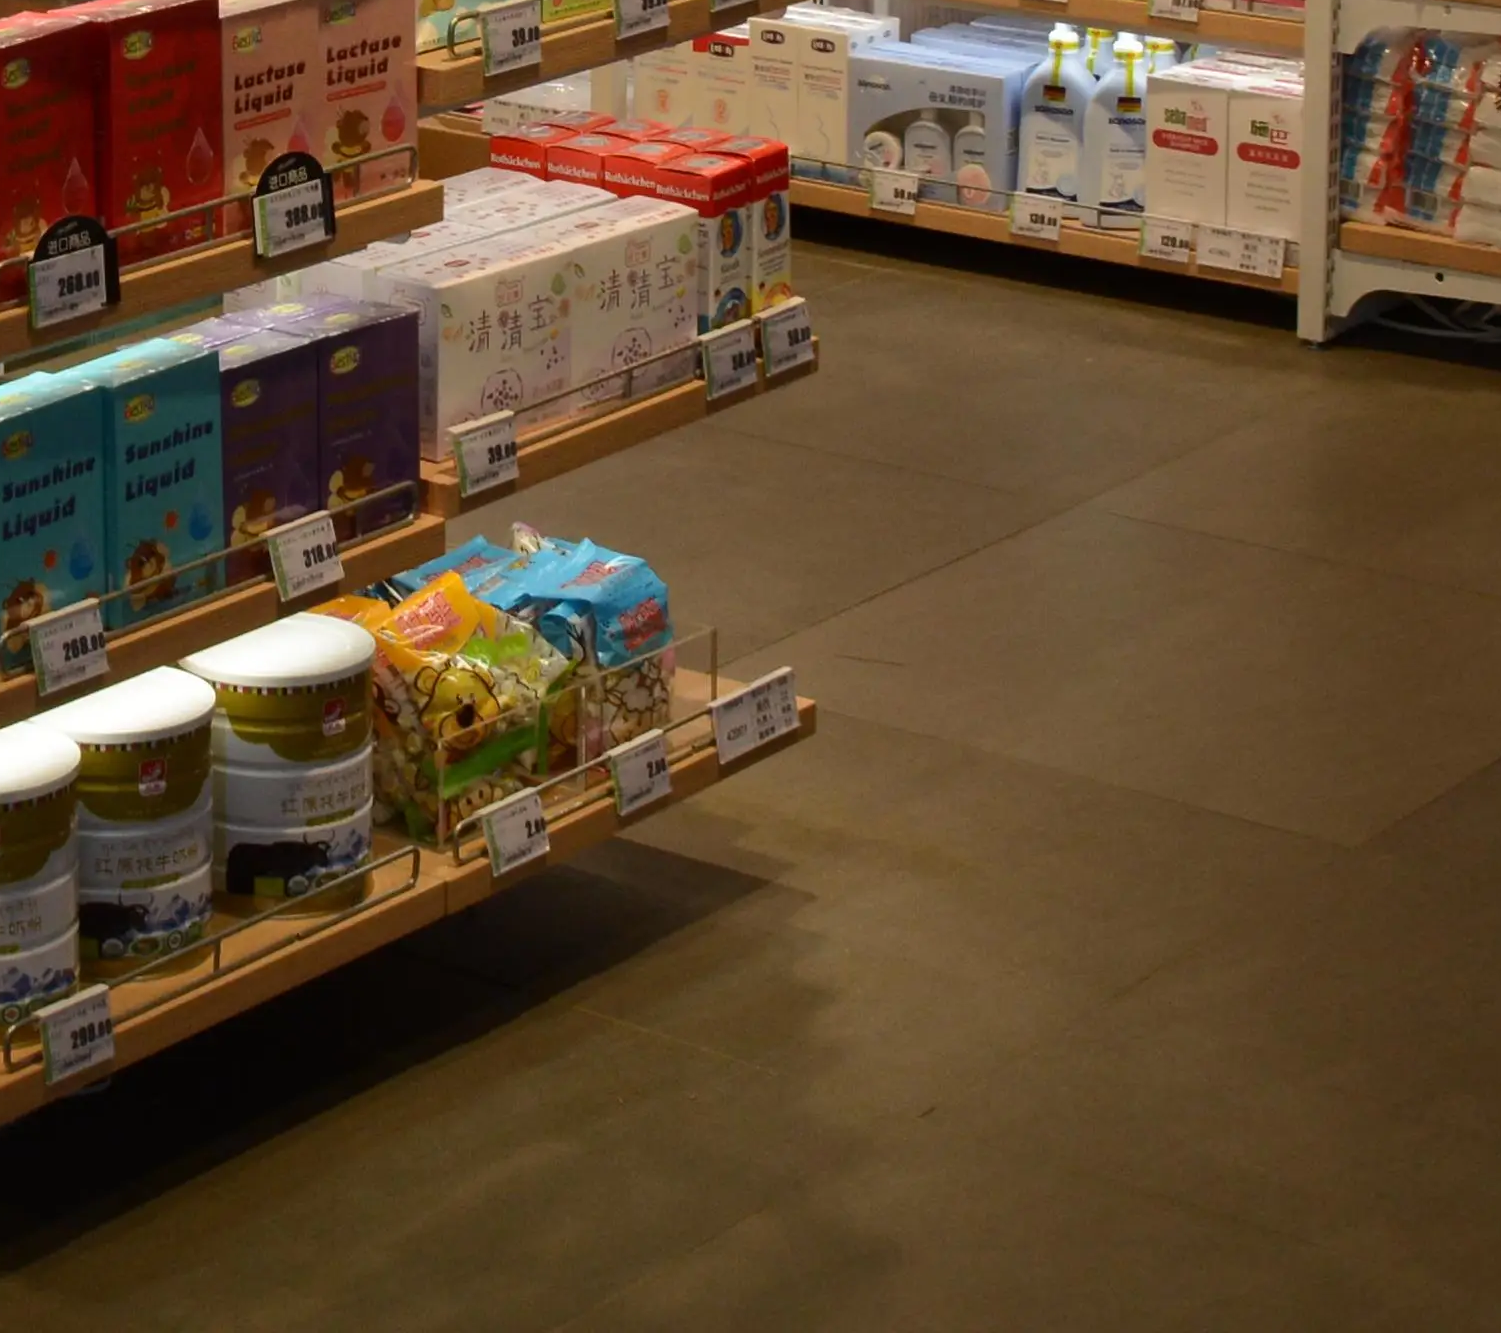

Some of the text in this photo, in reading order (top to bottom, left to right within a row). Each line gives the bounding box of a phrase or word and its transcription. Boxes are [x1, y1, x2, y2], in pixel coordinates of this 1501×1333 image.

[325, 34, 402, 66] Lactase
[234, 60, 306, 92] Lactase
[325, 57, 390, 88] Liquid
[233, 84, 294, 116] Liquid
[124, 418, 214, 464] Sunshine
[1, 454, 96, 503] Sunshine
[124, 457, 196, 504] Liquid
[1, 494, 78, 544] Liquid
